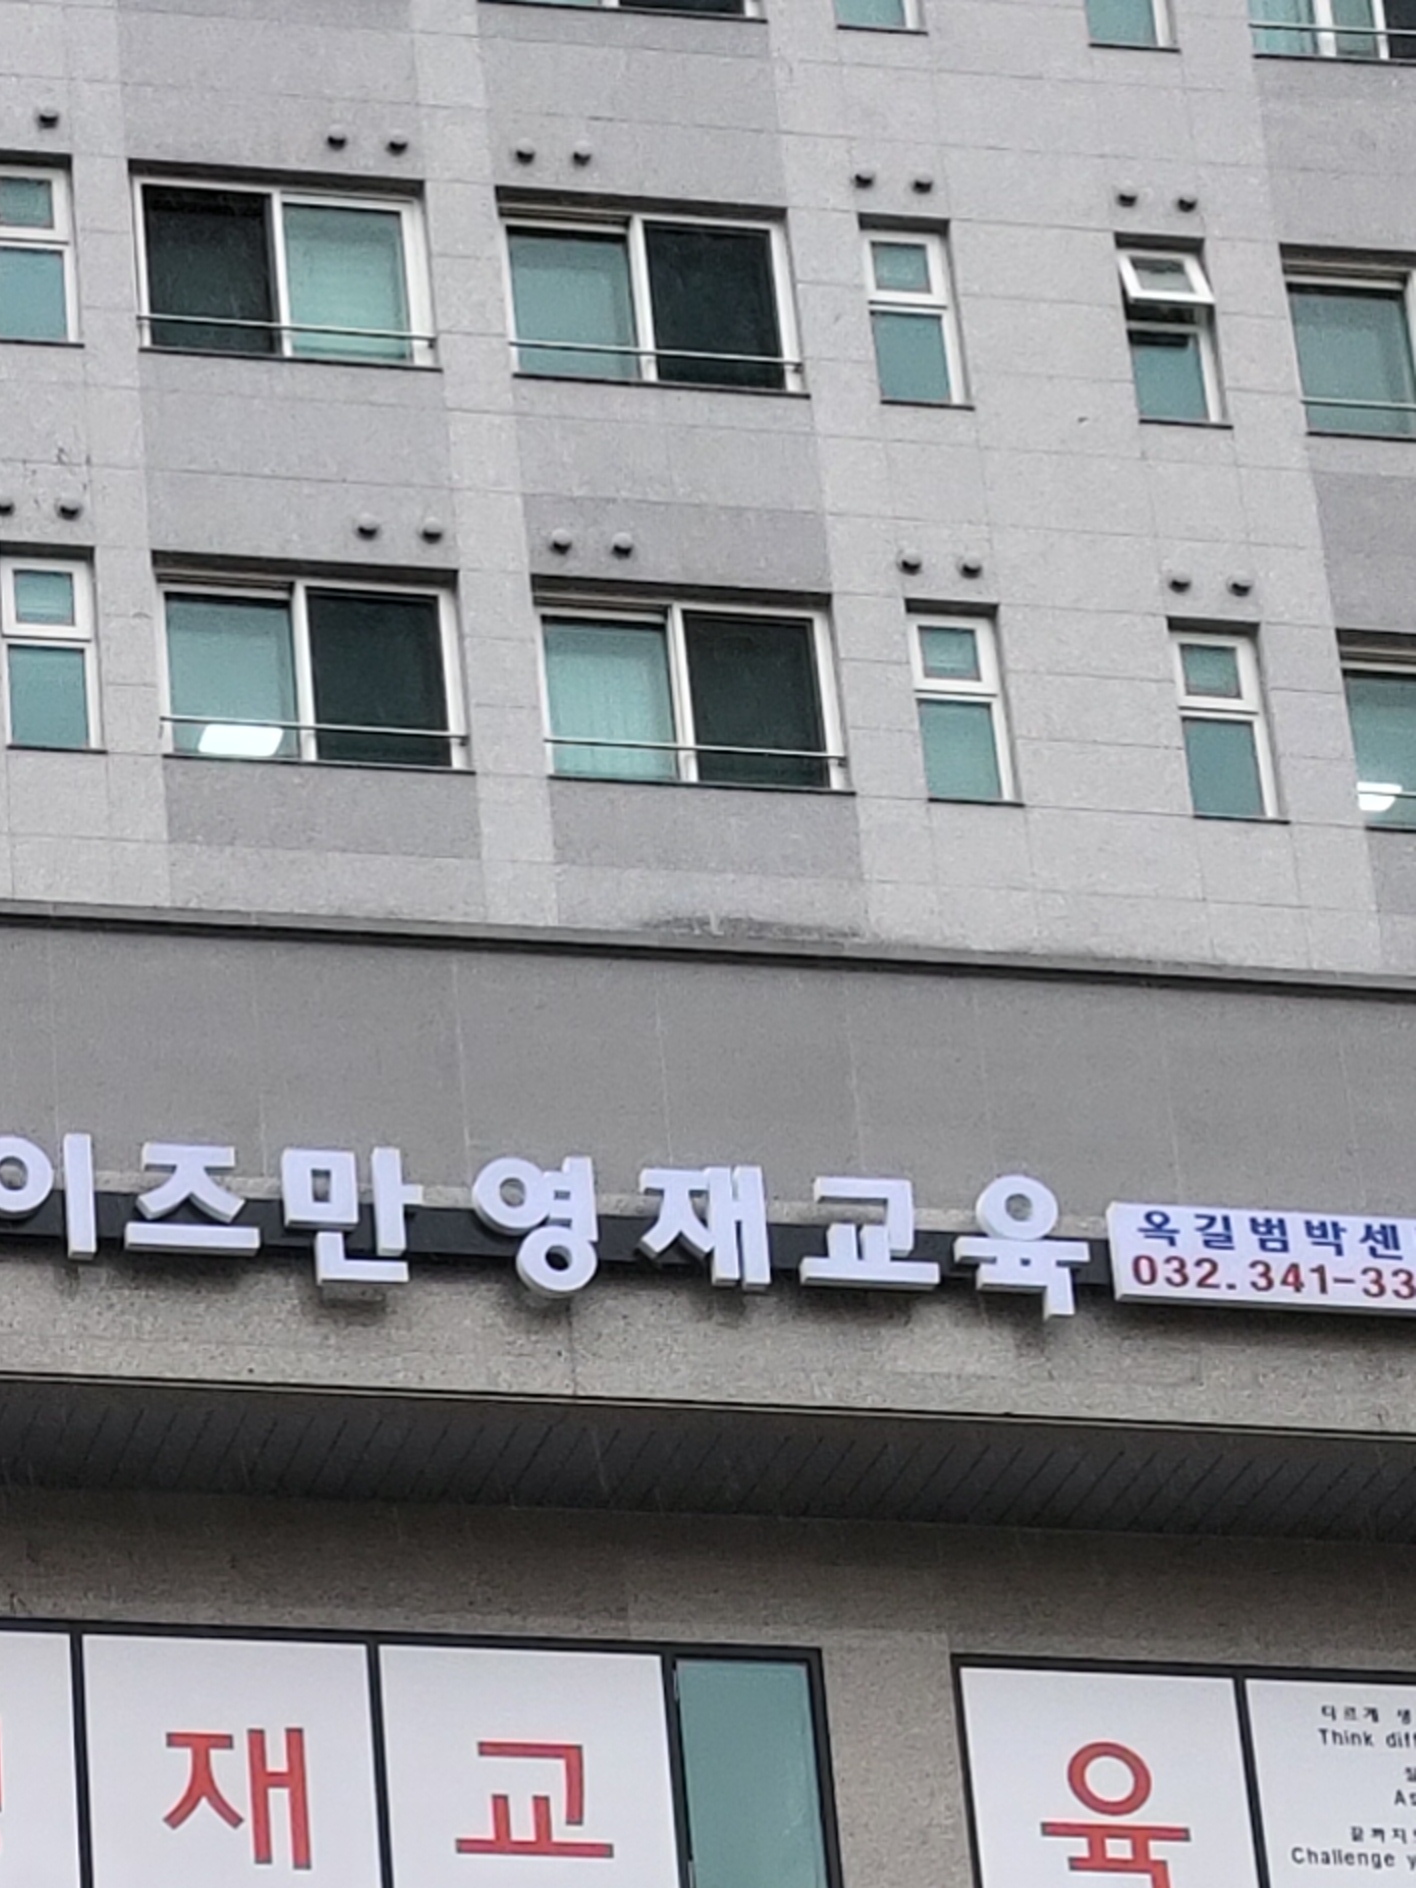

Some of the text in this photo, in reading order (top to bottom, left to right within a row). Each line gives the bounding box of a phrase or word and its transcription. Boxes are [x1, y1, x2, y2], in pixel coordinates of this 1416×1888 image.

[472, 1156, 1091, 1318] 영재교육
[1318, 1728, 1416, 1749] Think dif
[1351, 1826, 1416, 1845] 끝까지
[1291, 1847, 1395, 1869] Challenge
